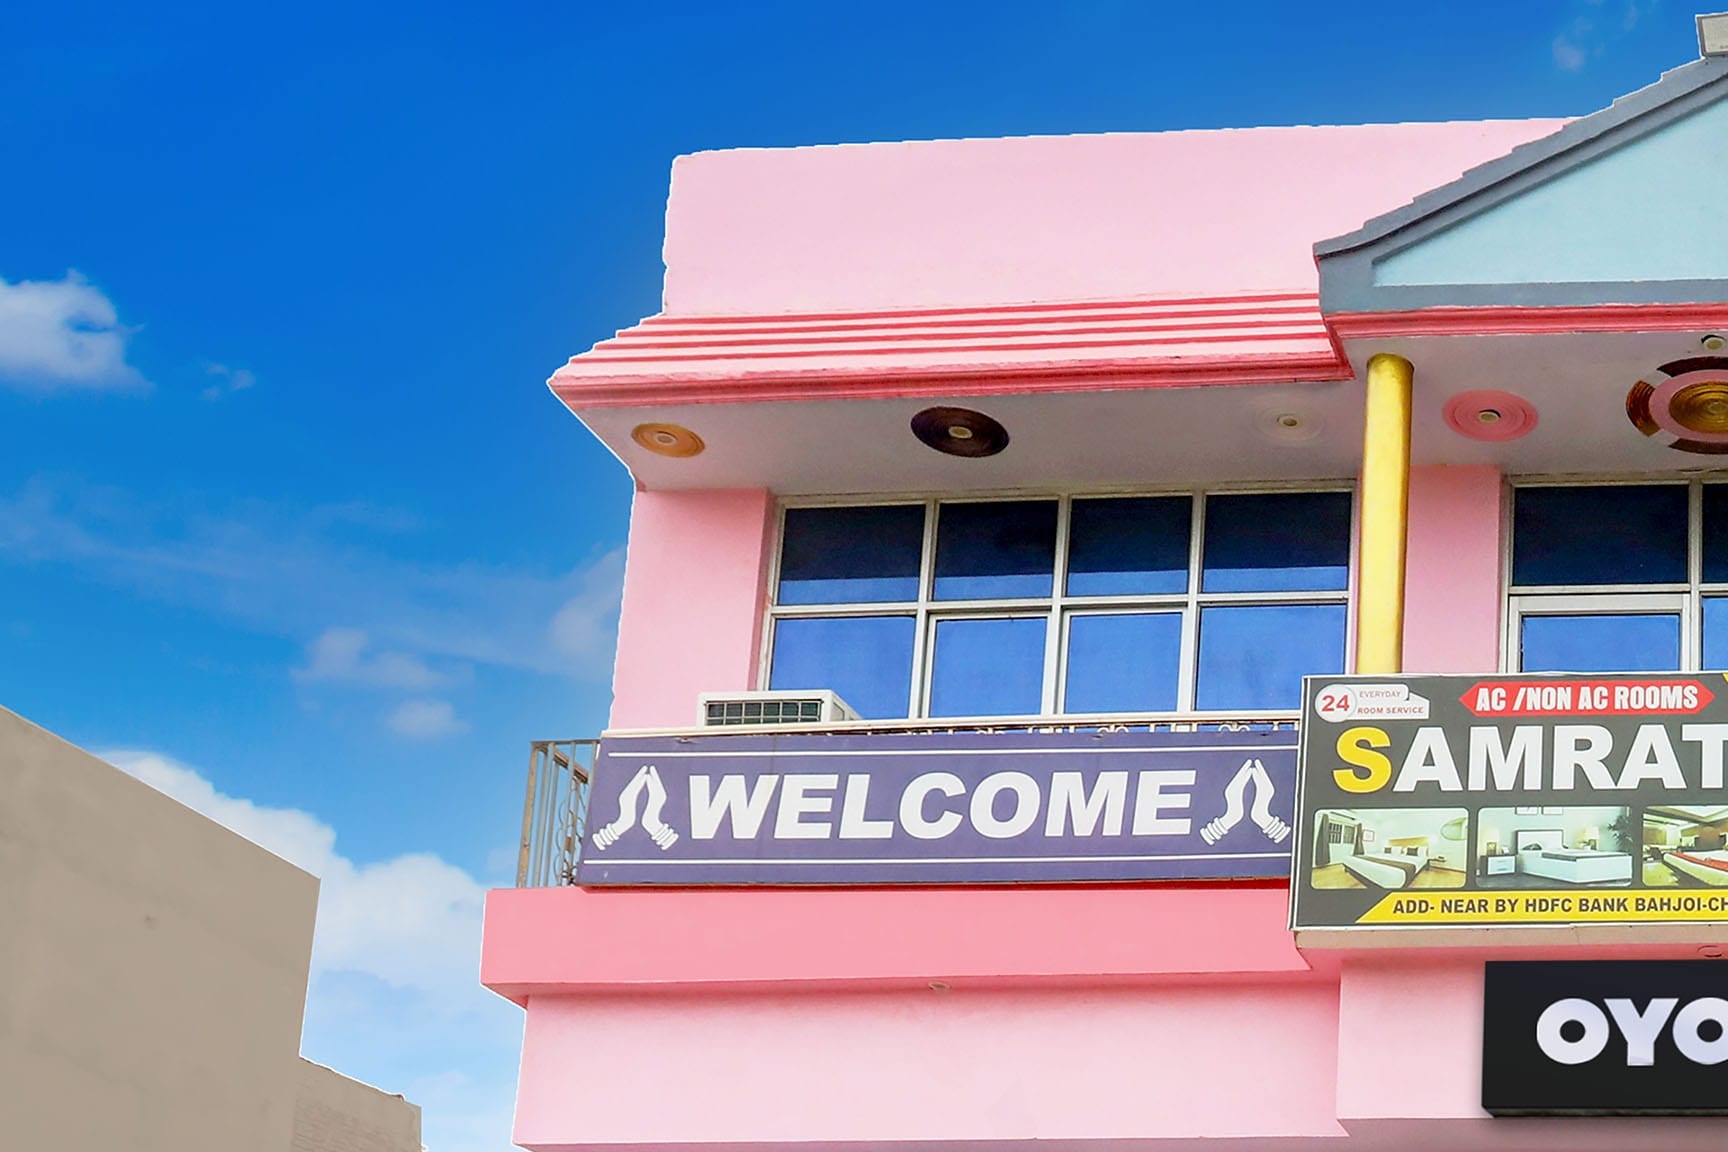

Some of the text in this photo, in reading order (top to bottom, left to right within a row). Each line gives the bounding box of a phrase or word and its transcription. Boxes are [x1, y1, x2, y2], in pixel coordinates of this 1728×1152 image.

[1359, 690, 1401, 698] EVERYDAY
[1475, 684, 1698, 712] AC /NON AC ROOMS
[1321, 694, 1350, 712] 24
[1386, 706, 1424, 714] SERVICE
[688, 770, 1197, 840] WELCOME
[1393, 899, 1435, 914] ADD-
[1441, 899, 1488, 913] NEAR
[1495, 898, 1518, 913] BY
[1525, 898, 1572, 912] HDFC
[1579, 897, 1628, 912] BANK
